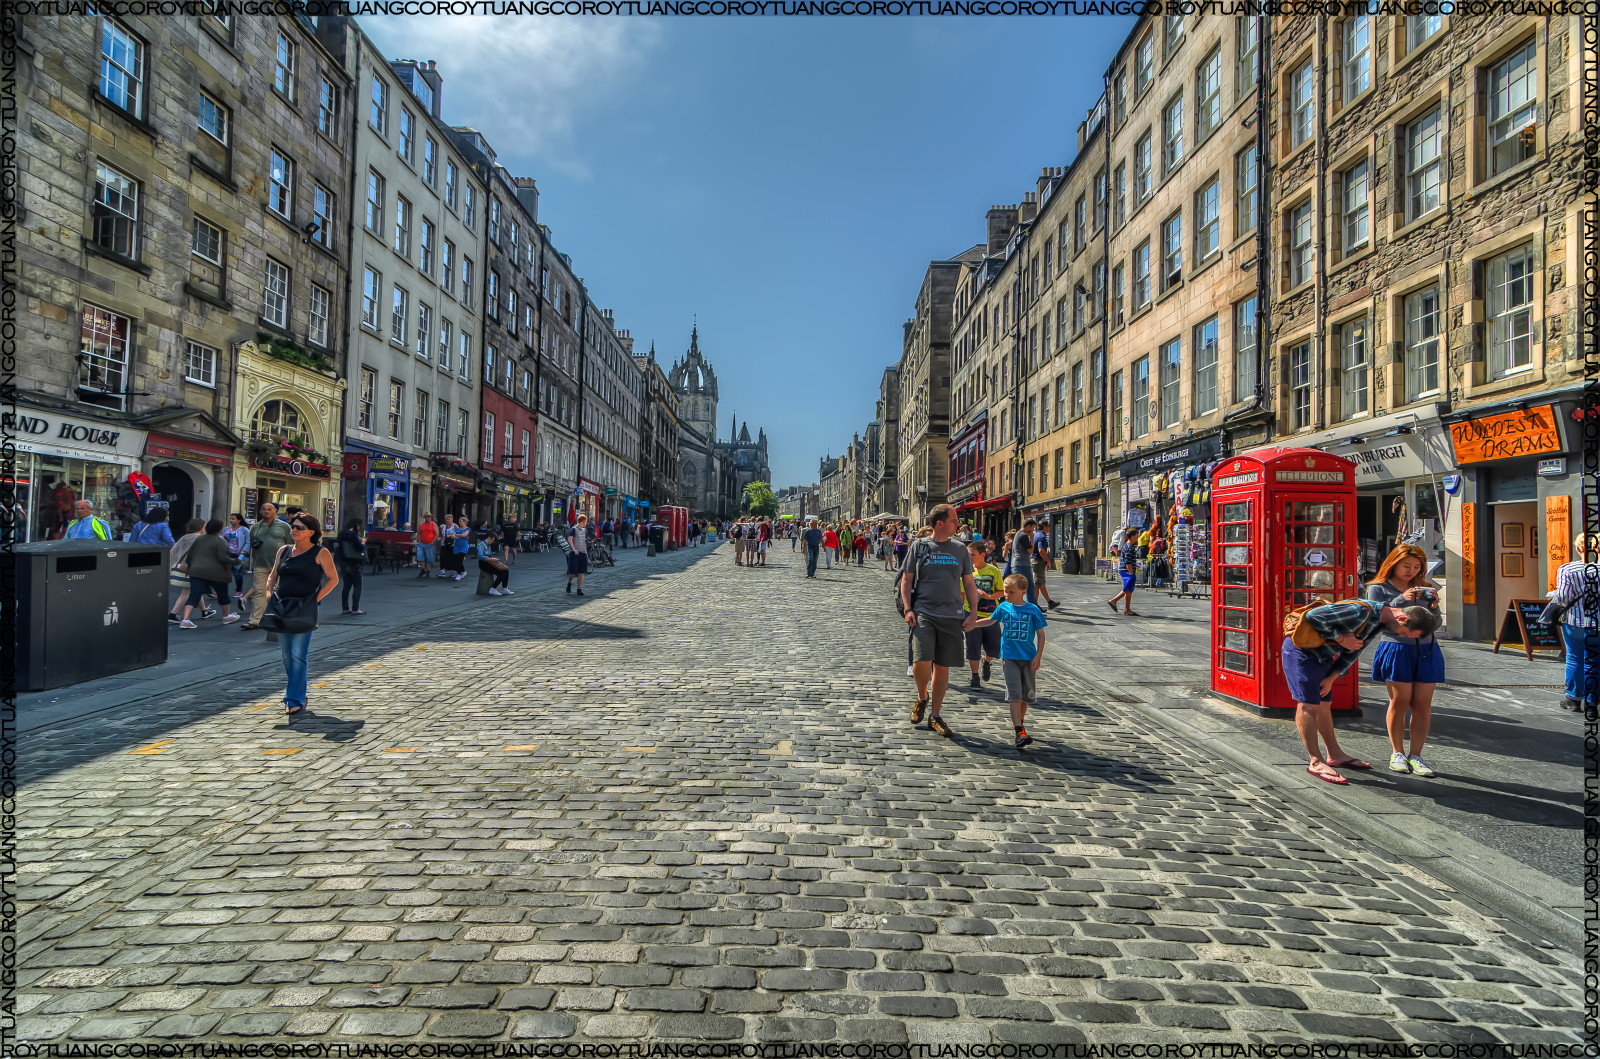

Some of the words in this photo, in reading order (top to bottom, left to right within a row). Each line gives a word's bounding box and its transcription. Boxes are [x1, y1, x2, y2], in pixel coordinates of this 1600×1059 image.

[58, 422, 121, 447] HOUSE
[1453, 412, 1539, 443] WILDEST
[1480, 431, 1555, 458] DRAMS
[1342, 445, 1406, 464] DINBURGH
[1220, 472, 1258, 486] TELEPHONE
[1279, 471, 1341, 482] TELEPHONE
[1362, 465, 1384, 475] MILE
[1463, 505, 1472, 581] RESTAURANT
[1550, 543, 1567, 551] Craft
[1551, 553, 1565, 561] Beer
